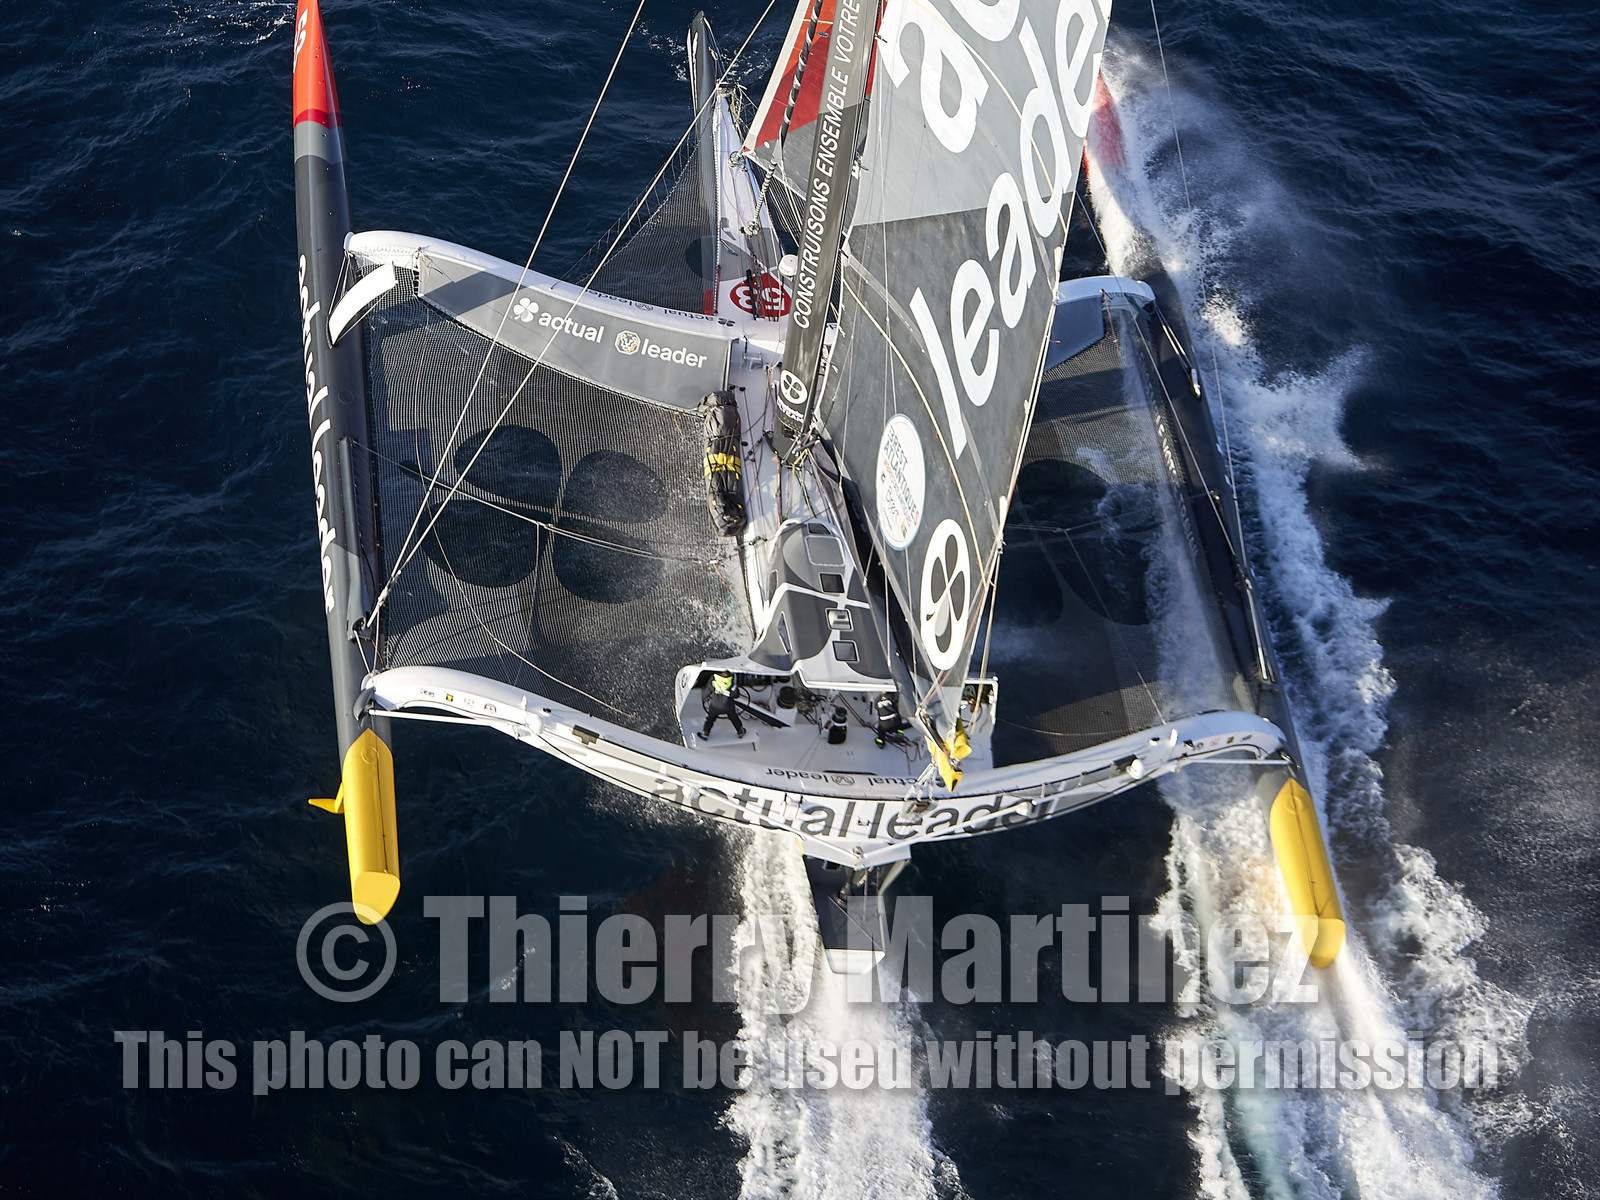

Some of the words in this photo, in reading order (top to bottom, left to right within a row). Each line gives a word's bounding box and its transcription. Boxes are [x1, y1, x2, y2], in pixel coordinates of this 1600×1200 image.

[793, 176, 831, 329] CONSTRUISONS
[815, 65, 849, 178] ENSEMBLE
[735, 287, 786, 311] 53
[537, 311, 605, 344] actual
[640, 338, 708, 369] leader
[765, 767, 830, 784] leader
[650, 778, 857, 839] actual
